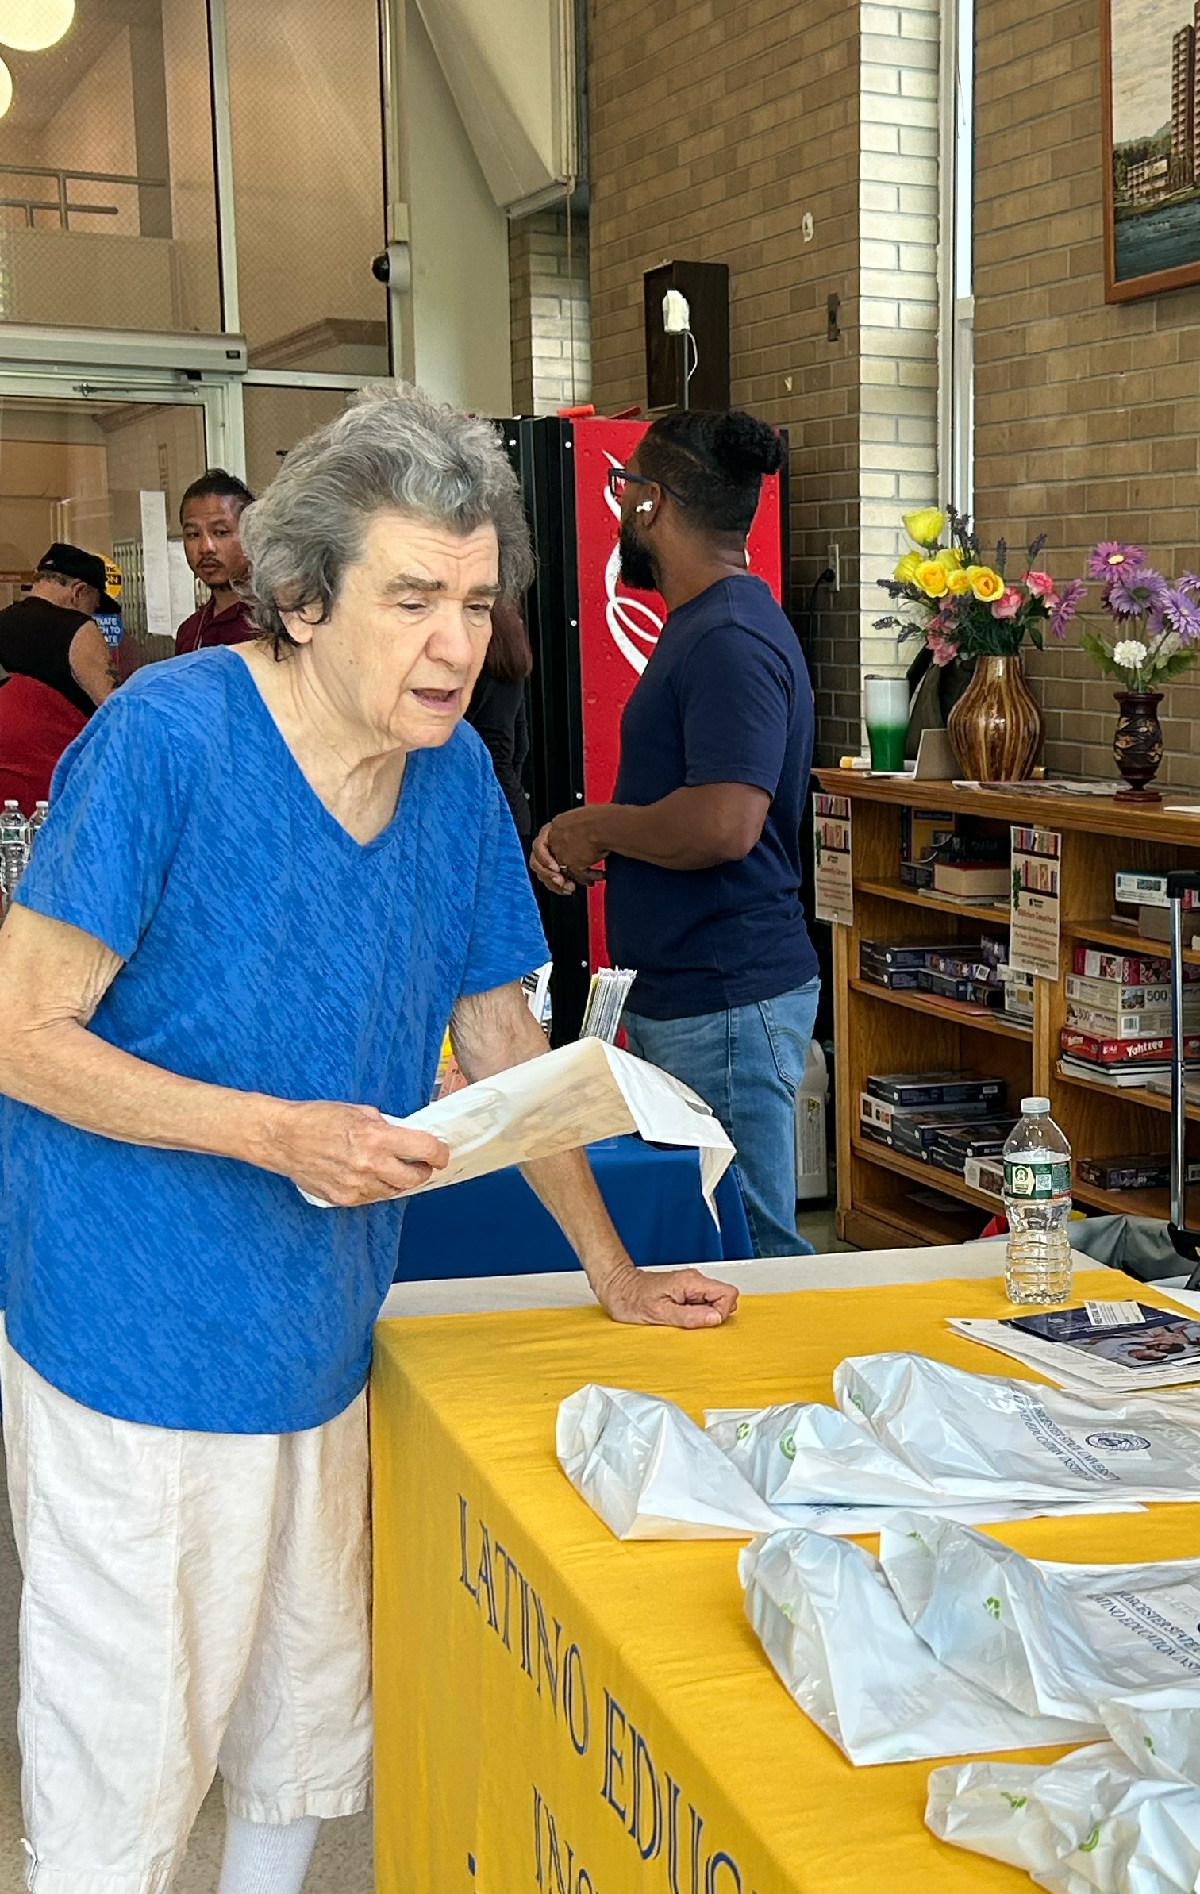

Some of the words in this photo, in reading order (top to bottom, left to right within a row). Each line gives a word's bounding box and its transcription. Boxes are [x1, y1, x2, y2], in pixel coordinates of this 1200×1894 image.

[1146, 990, 1168, 1002] 500
[1126, 1040, 1164, 1058] Yahtzee
[457, 1493, 591, 1755] LATINO
